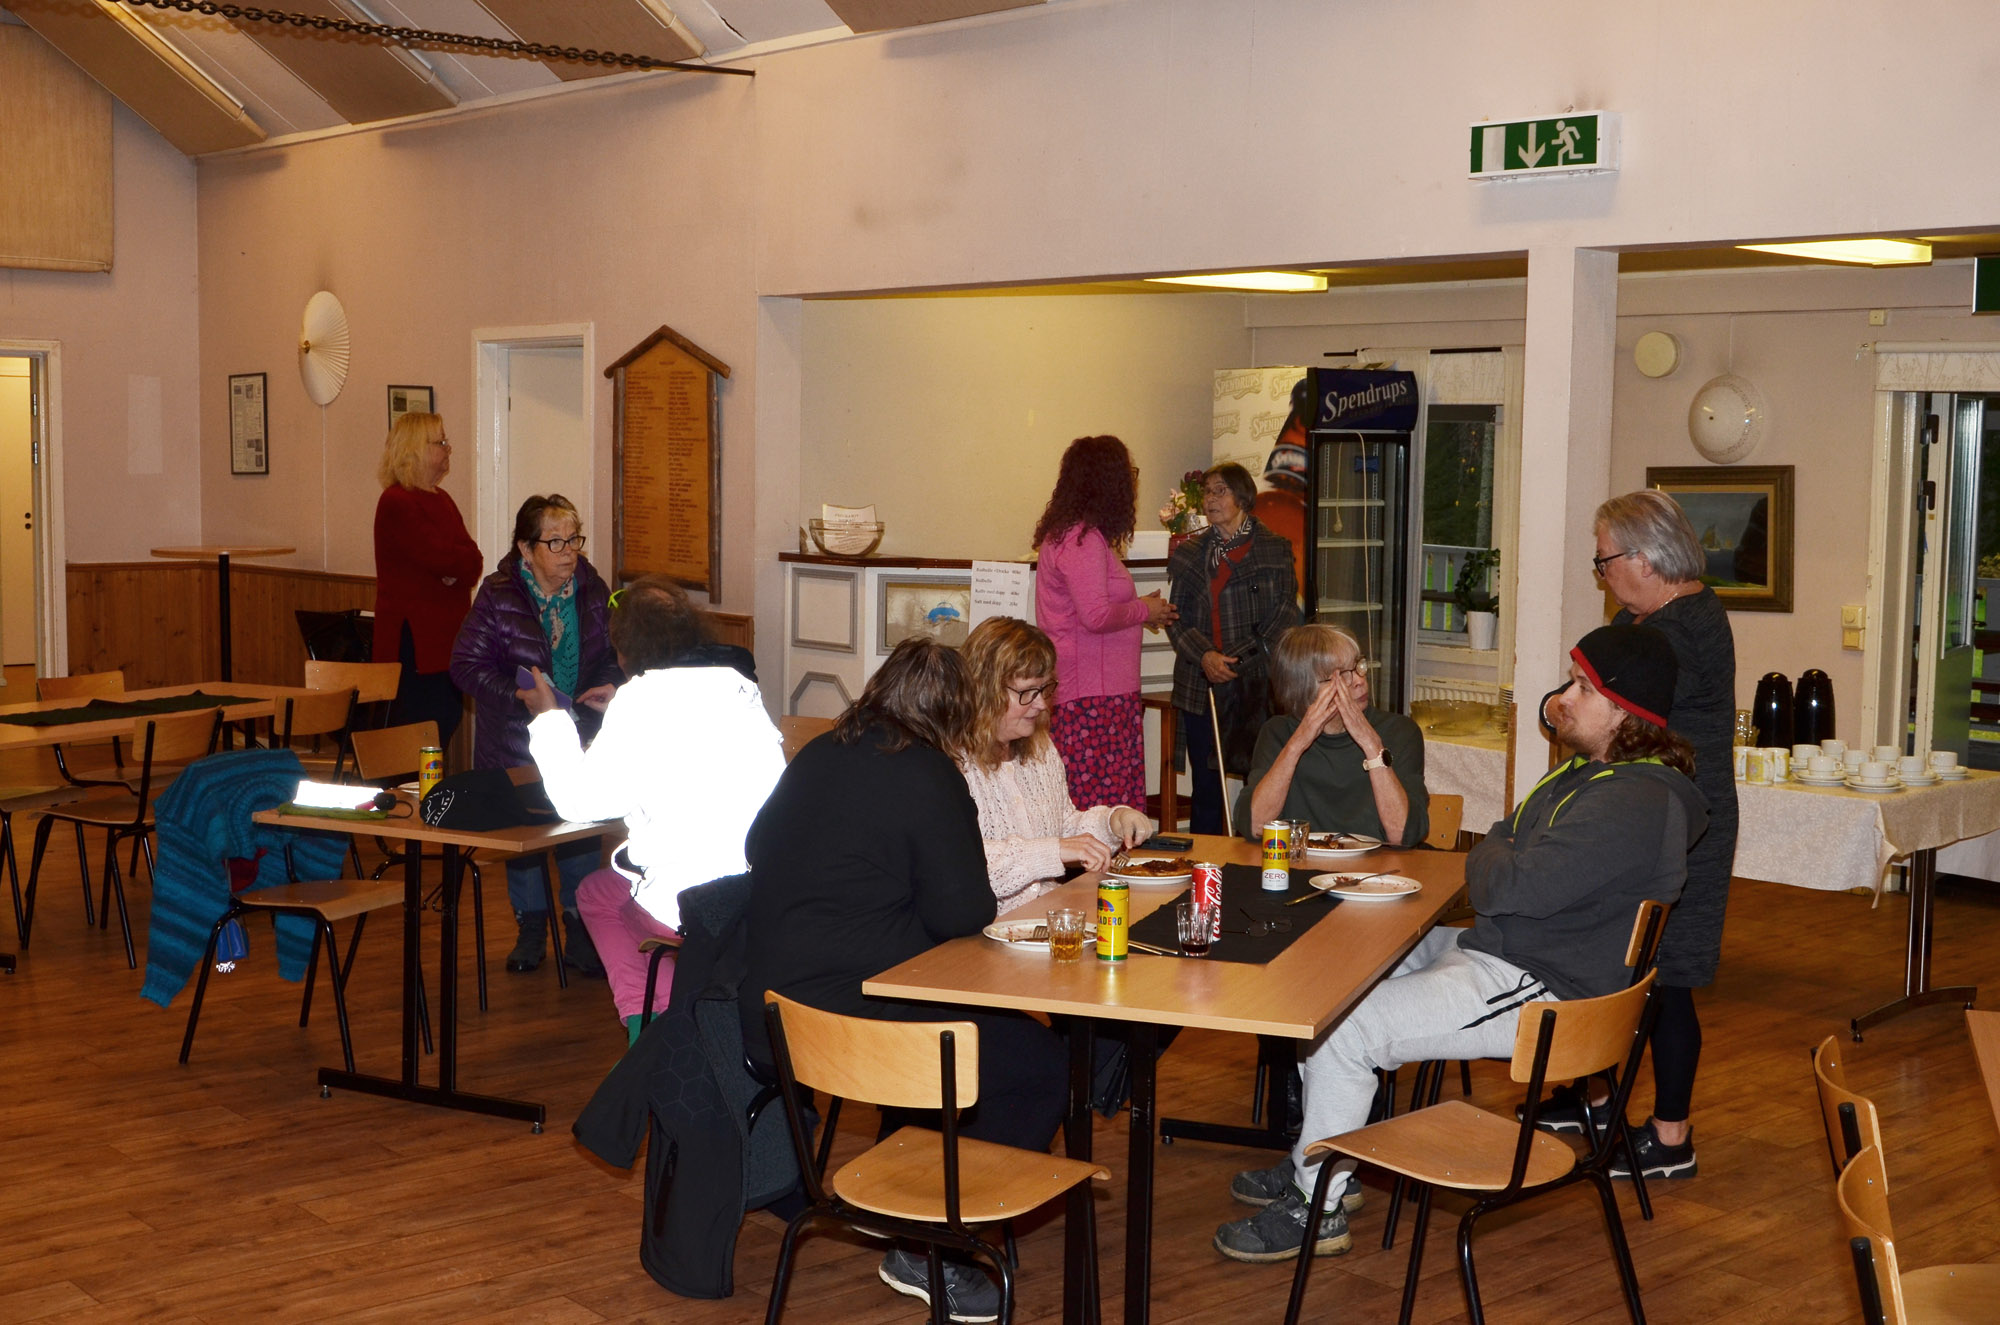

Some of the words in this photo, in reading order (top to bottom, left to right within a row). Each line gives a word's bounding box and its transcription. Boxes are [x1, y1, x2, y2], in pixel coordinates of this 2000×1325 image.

[1214, 373, 1260, 398] SPENDRUPS
[1321, 379, 1408, 423] Spendrups
[1264, 872, 1287, 880] ZERO
